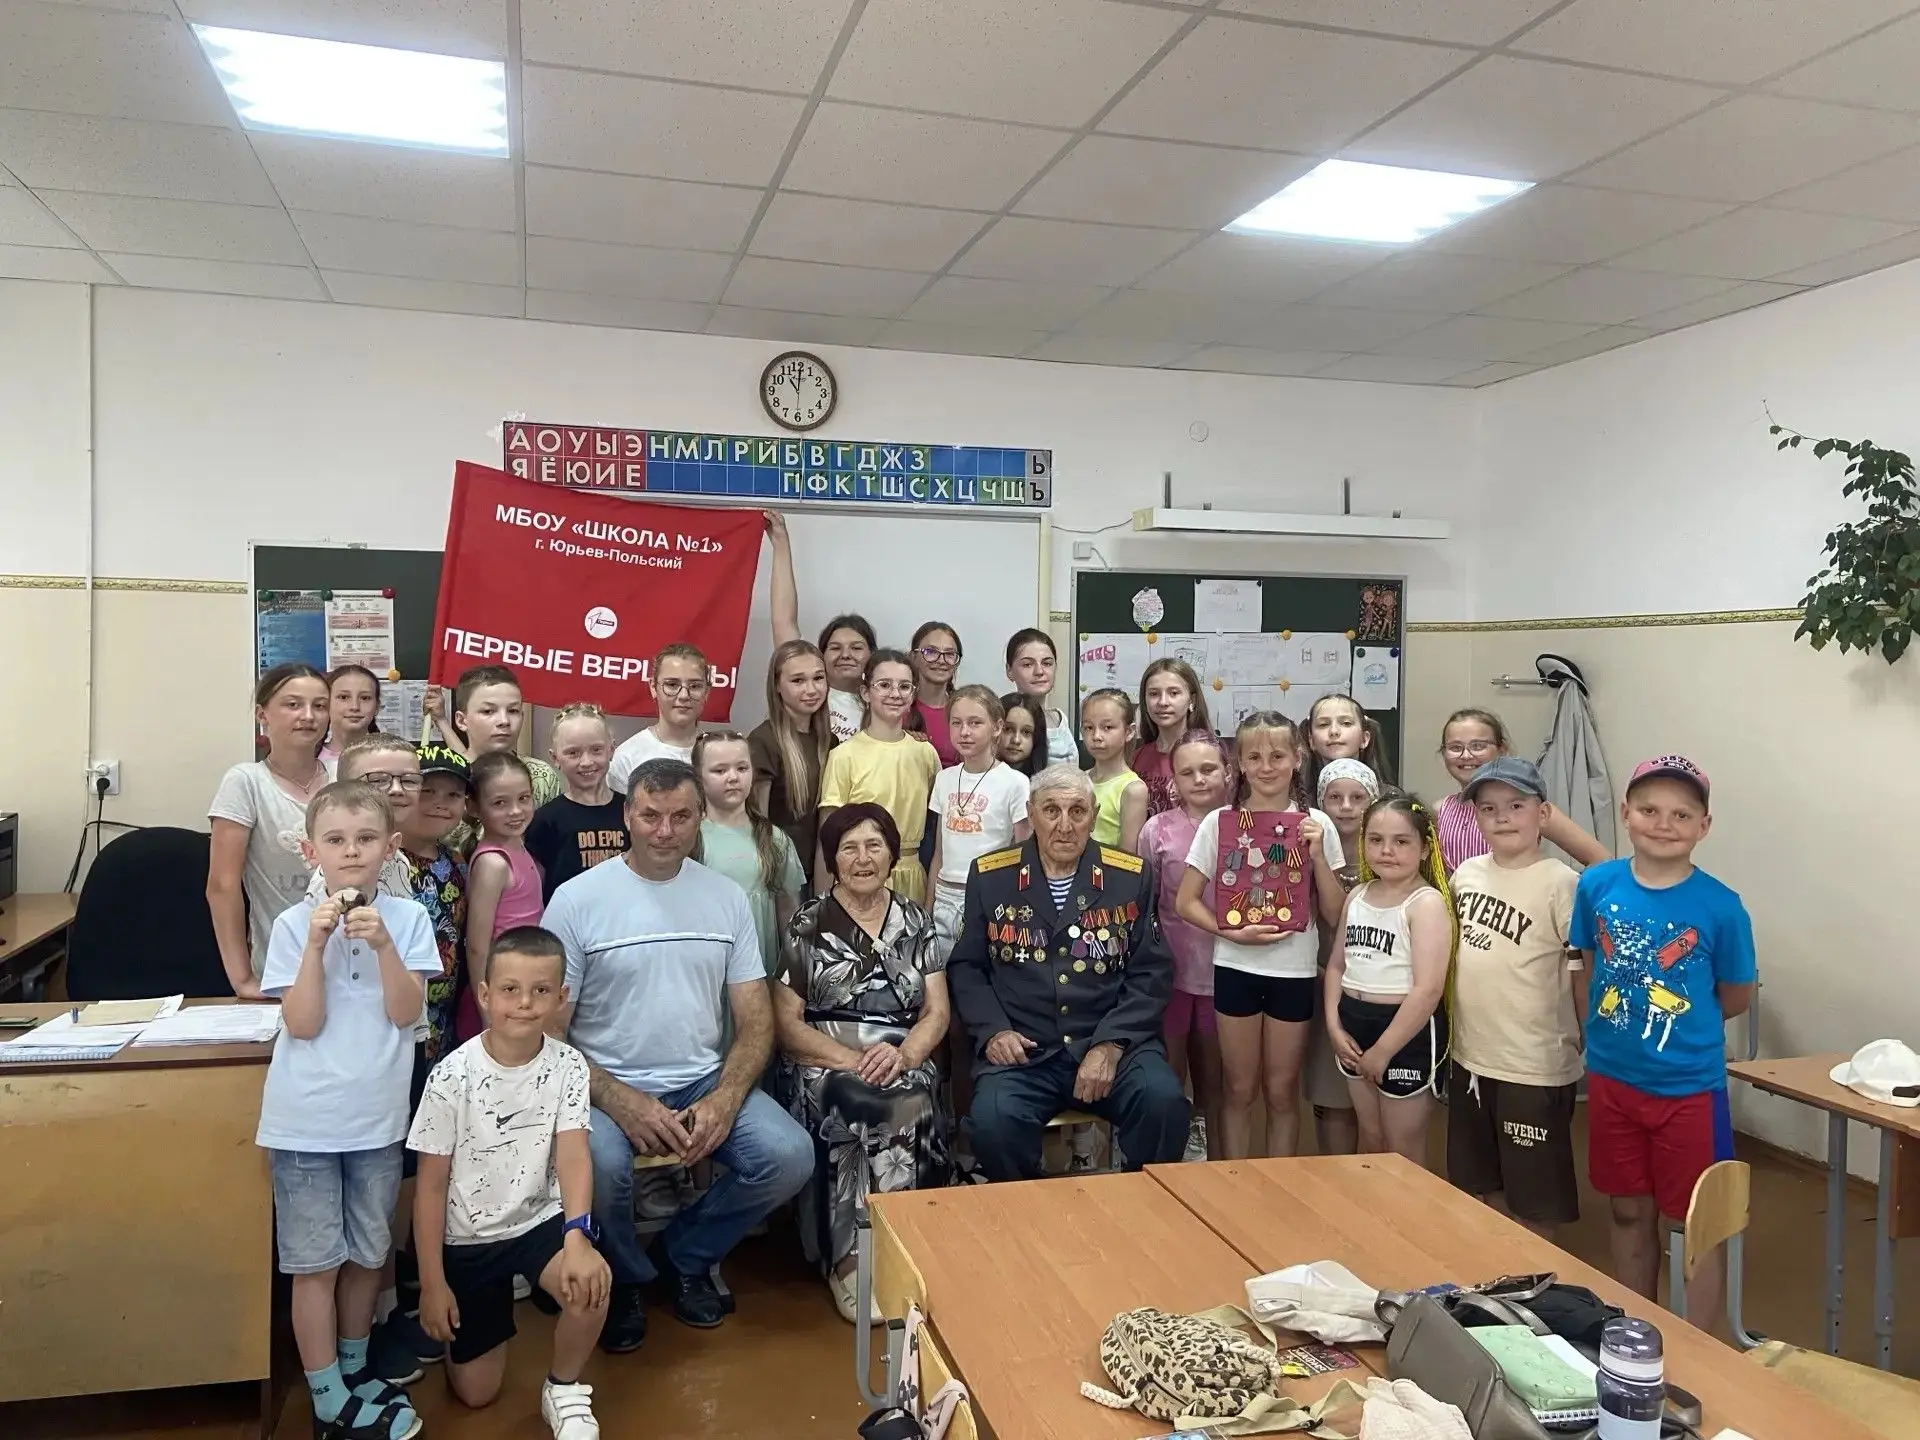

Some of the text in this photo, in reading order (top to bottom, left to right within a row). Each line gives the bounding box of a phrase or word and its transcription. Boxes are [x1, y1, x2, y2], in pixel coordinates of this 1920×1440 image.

[781, 365, 792, 376] 11
[790, 361, 804, 372] 12
[807, 366, 813, 377] 1
[771, 374, 784, 385] 10
[815, 376, 822, 387] 2
[768, 385, 775, 396] 9
[820, 388, 827, 398] 3
[772, 396, 780, 407] 8
[815, 399, 822, 409] 4
[782, 407, 789, 418] 7
[794, 411, 801, 422] 6
[807, 408, 814, 418] 5
[509, 428, 1046, 474] А О У Ы Э Н М Л Р Й Б В Г Д Ж З Ь
[511, 456, 1045, 504] Я Ё Ю И Е П Ф К Т Ш С Х Ц Ч Щ Ъ
[495, 504, 724, 553] МБОУ «ШКОЛА №1»
[535, 538, 683, 570] г. Юрьев-Польский
[444, 627, 736, 688] ПЕРВЫЕ ВЕРЫ
[577, 830, 625, 849] DO EPIC
[1458, 891, 1533, 946] EVERLY
[1344, 924, 1396, 957] BROOKLYN
[1462, 924, 1492, 951] Hills
[1388, 1068, 1422, 1081] BROOKLYN
[1503, 1120, 1548, 1142] BEVERLY
